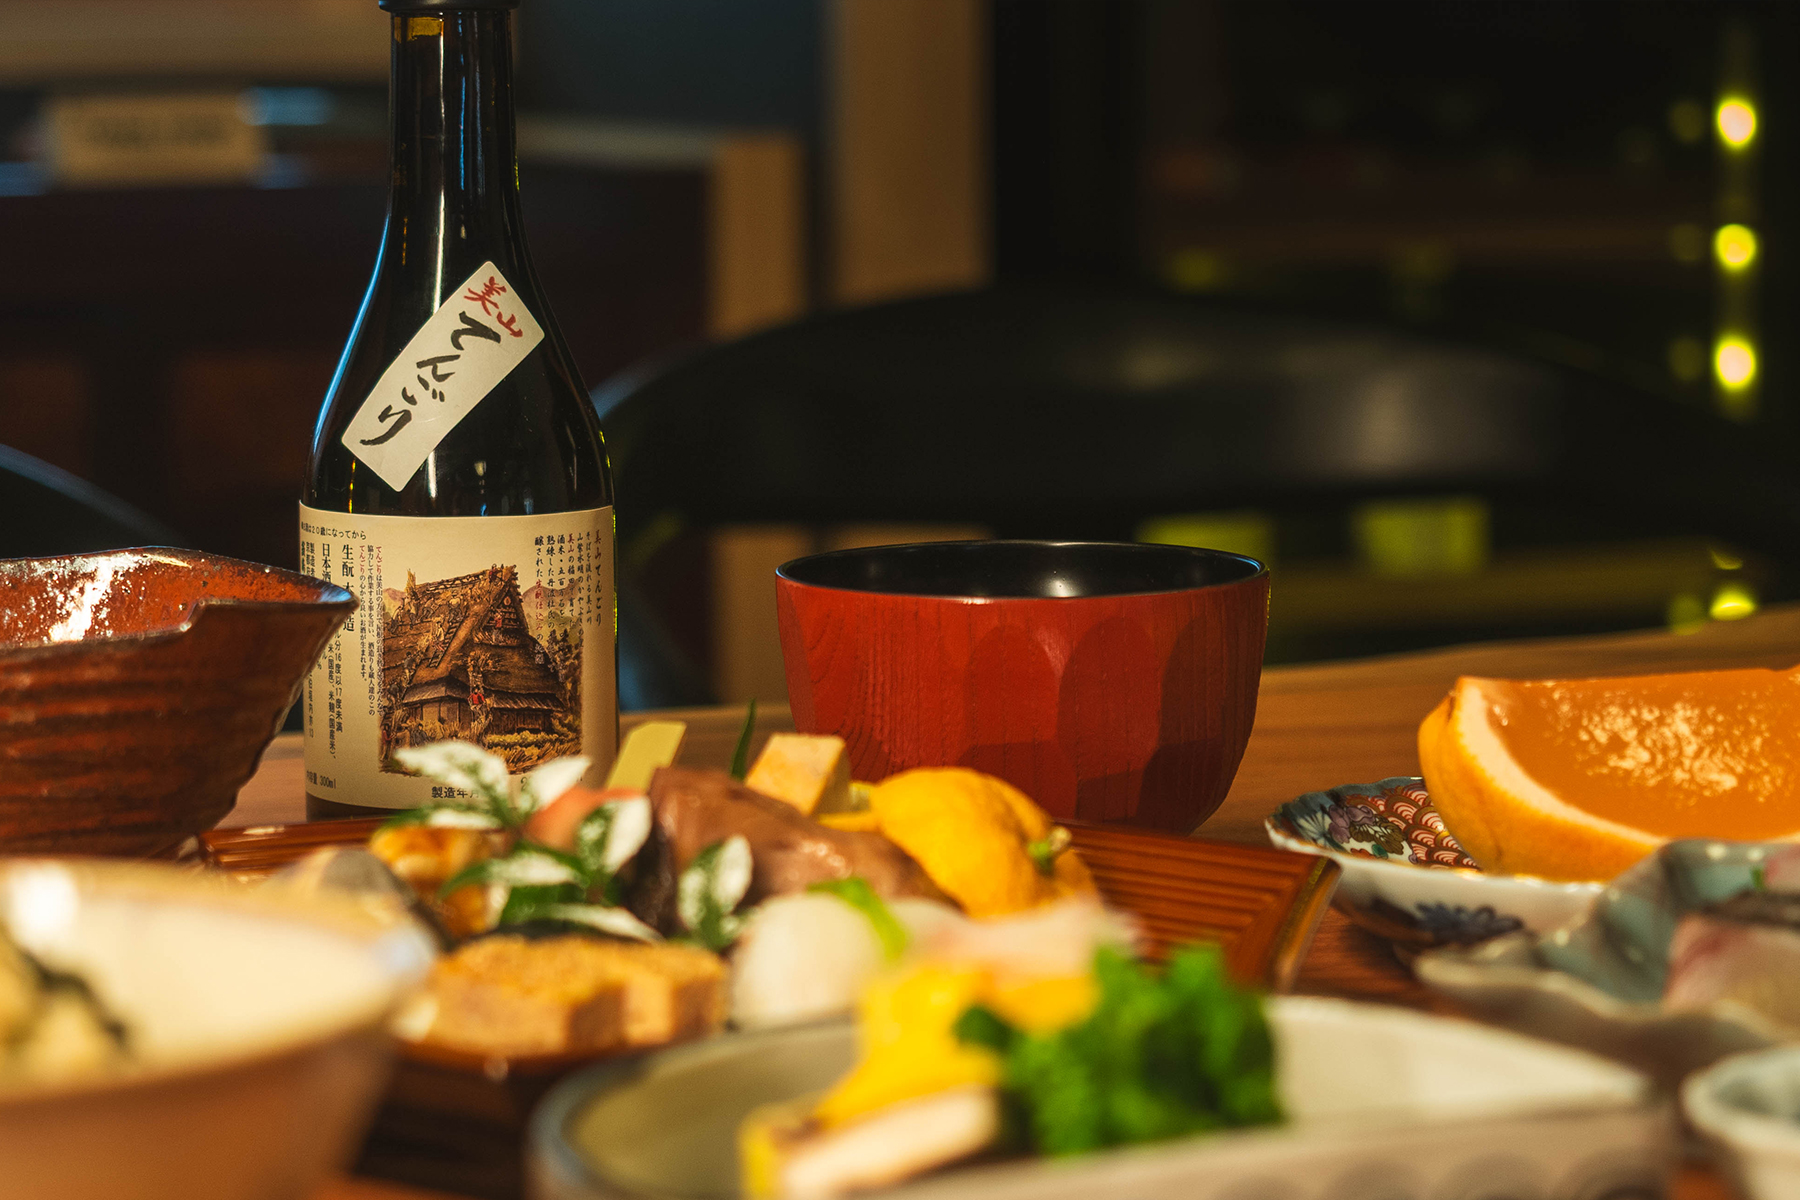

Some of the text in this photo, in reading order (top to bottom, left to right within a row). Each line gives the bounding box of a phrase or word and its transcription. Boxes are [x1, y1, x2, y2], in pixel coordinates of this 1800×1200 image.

[463, 276, 523, 338] 美山
[360, 311, 501, 446] てんごり
